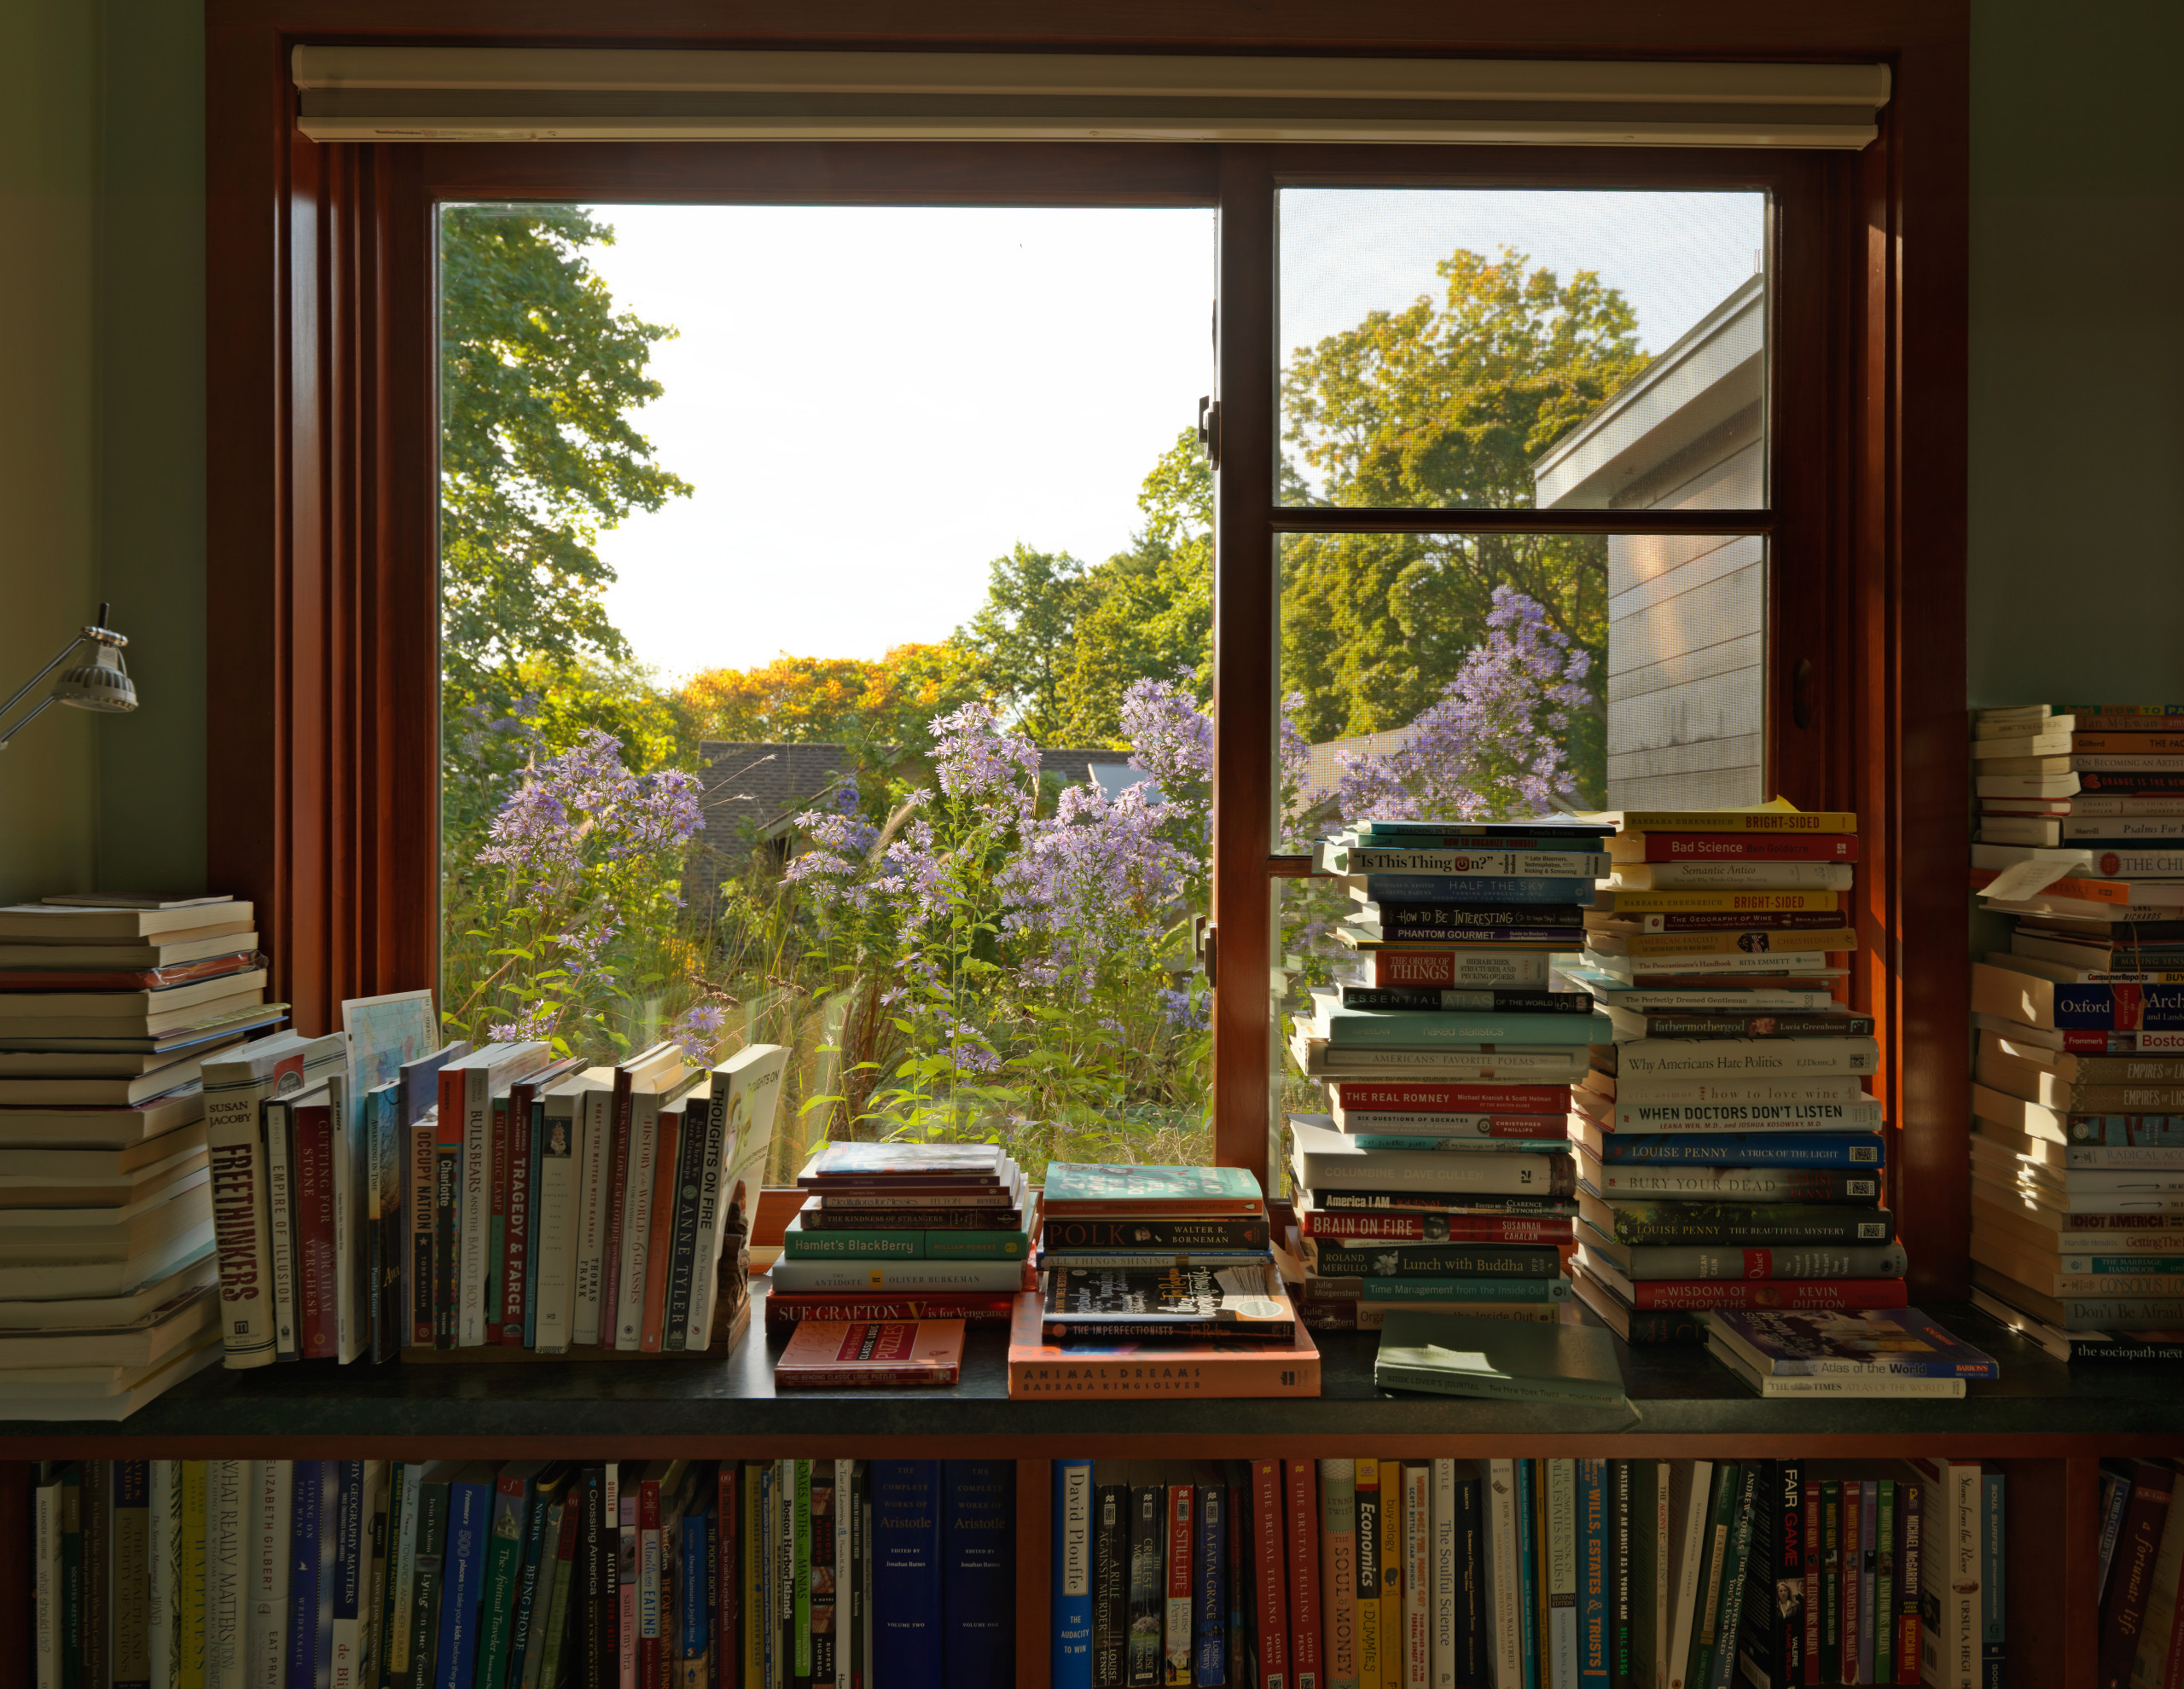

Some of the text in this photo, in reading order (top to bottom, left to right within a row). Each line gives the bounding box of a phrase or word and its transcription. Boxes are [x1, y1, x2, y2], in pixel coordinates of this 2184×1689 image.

[1745, 816, 1820, 828] BRIGHT-SIDED
[1672, 842, 1742, 853] Bad Science
[1374, 855, 1408, 868] This
[1409, 856, 1452, 872] Thing
[1449, 880, 1545, 891] HALF THE SKY
[1734, 897, 1804, 908] BRIGHT-SIDED
[1397, 930, 1495, 940] PHANTOM GOURMET
[1391, 957, 1449, 966] THE ORDER OF
[1391, 965, 1449, 979] THINGS
[2061, 999, 2110, 1014] Oxford
[1423, 1025, 1504, 1036] naked statistics
[1655, 1020, 1745, 1032] fathermothergod
[1443, 1054, 1492, 1065] FAVORITE
[1498, 1056, 1535, 1065] POEMS
[1629, 1056, 1782, 1073] Why Americans Hate Politics
[209, 1101, 247, 1111] SUSAN
[1346, 1093, 1449, 1103] THE REAL ROMNEY
[210, 1112, 252, 1126] JACOBY
[1639, 1106, 1842, 1121] WHEN DOCTORS DON'T LISTEN
[700, 1089, 723, 1230] THOUGHTS ON FIRE
[1632, 1146, 1728, 1159] LOUISE PENNY
[1791, 1150, 1808, 1158] THE
[305, 1148, 314, 1197] STONE
[316, 1120, 329, 1222] CUTTING FOR
[418, 1132, 432, 1230] OCCUPY NATION
[439, 1160, 452, 1207] Charlotte
[511, 1158, 526, 1236] TRAGEDY
[212, 1144, 259, 1302] FREETHINKERS
[1174, 1226, 1213, 1234] WALTER
[1314, 1217, 1413, 1235] BRAIN ON FIRE
[1502, 1221, 1541, 1231] SUSANNAH
[273, 1165, 290, 1303] EMPIRE OF ILLUSION
[1048, 1223, 1126, 1245] POLK
[1504, 1232, 1537, 1240] CAHALAN
[795, 1239, 914, 1253] Hamlet's BlackBerry
[671, 1207, 693, 1323] ANNE TYLER
[1322, 1263, 1367, 1272] MERULLO
[1403, 1258, 1523, 1271] Lunch with Buddha
[579, 1261, 588, 1297] FRANK
[590, 1258, 598, 1302] THOMAS
[508, 1261, 522, 1315] FARCE
[1370, 1286, 1545, 1297] Time Management from the Inside Out
[779, 1302, 1010, 1320] SUE GRAFTON V is for Vengeance
[2074, 1303, 2182, 1319] Don't Be Afraid
[1073, 1326, 1173, 1335] THE IMPERFECTIONISTS
[2078, 1346, 2097, 1357] the
[2100, 1346, 2156, 1360] sociopath
[1025, 1368, 1200, 1379] ANIMAL DREAMS
[1024, 1381, 1200, 1391] BARBARA KINGSOLVER
[1588, 1489, 1601, 1535] WILLS,
[1785, 1469, 1798, 1567] FAIR GAME
[531, 1503, 543, 1541] NORRIS
[880, 1517, 932, 1529] Aristotle
[956, 1518, 1005, 1529] Aristotle
[1068, 1473, 1085, 1590] David Plouffe
[589, 1489, 598, 1595] Crossing America
[1361, 1502, 1376, 1587] Economics
[262, 1536, 273, 1592] GILBERT
[1176, 1529, 1188, 1589] STILL LIFE
[1589, 1539, 1601, 1595] ESTATES
[1441, 1520, 1451, 1646] The Soulful Science
[2118, 1522, 2153, 1634] a fortunate life
[515, 1564, 536, 1651] BEING HOME
[783, 1579, 792, 1620] Islands
[1061, 1629, 1089, 1639] AUDACITY
[1588, 1617, 1601, 1668] TRUSTS
